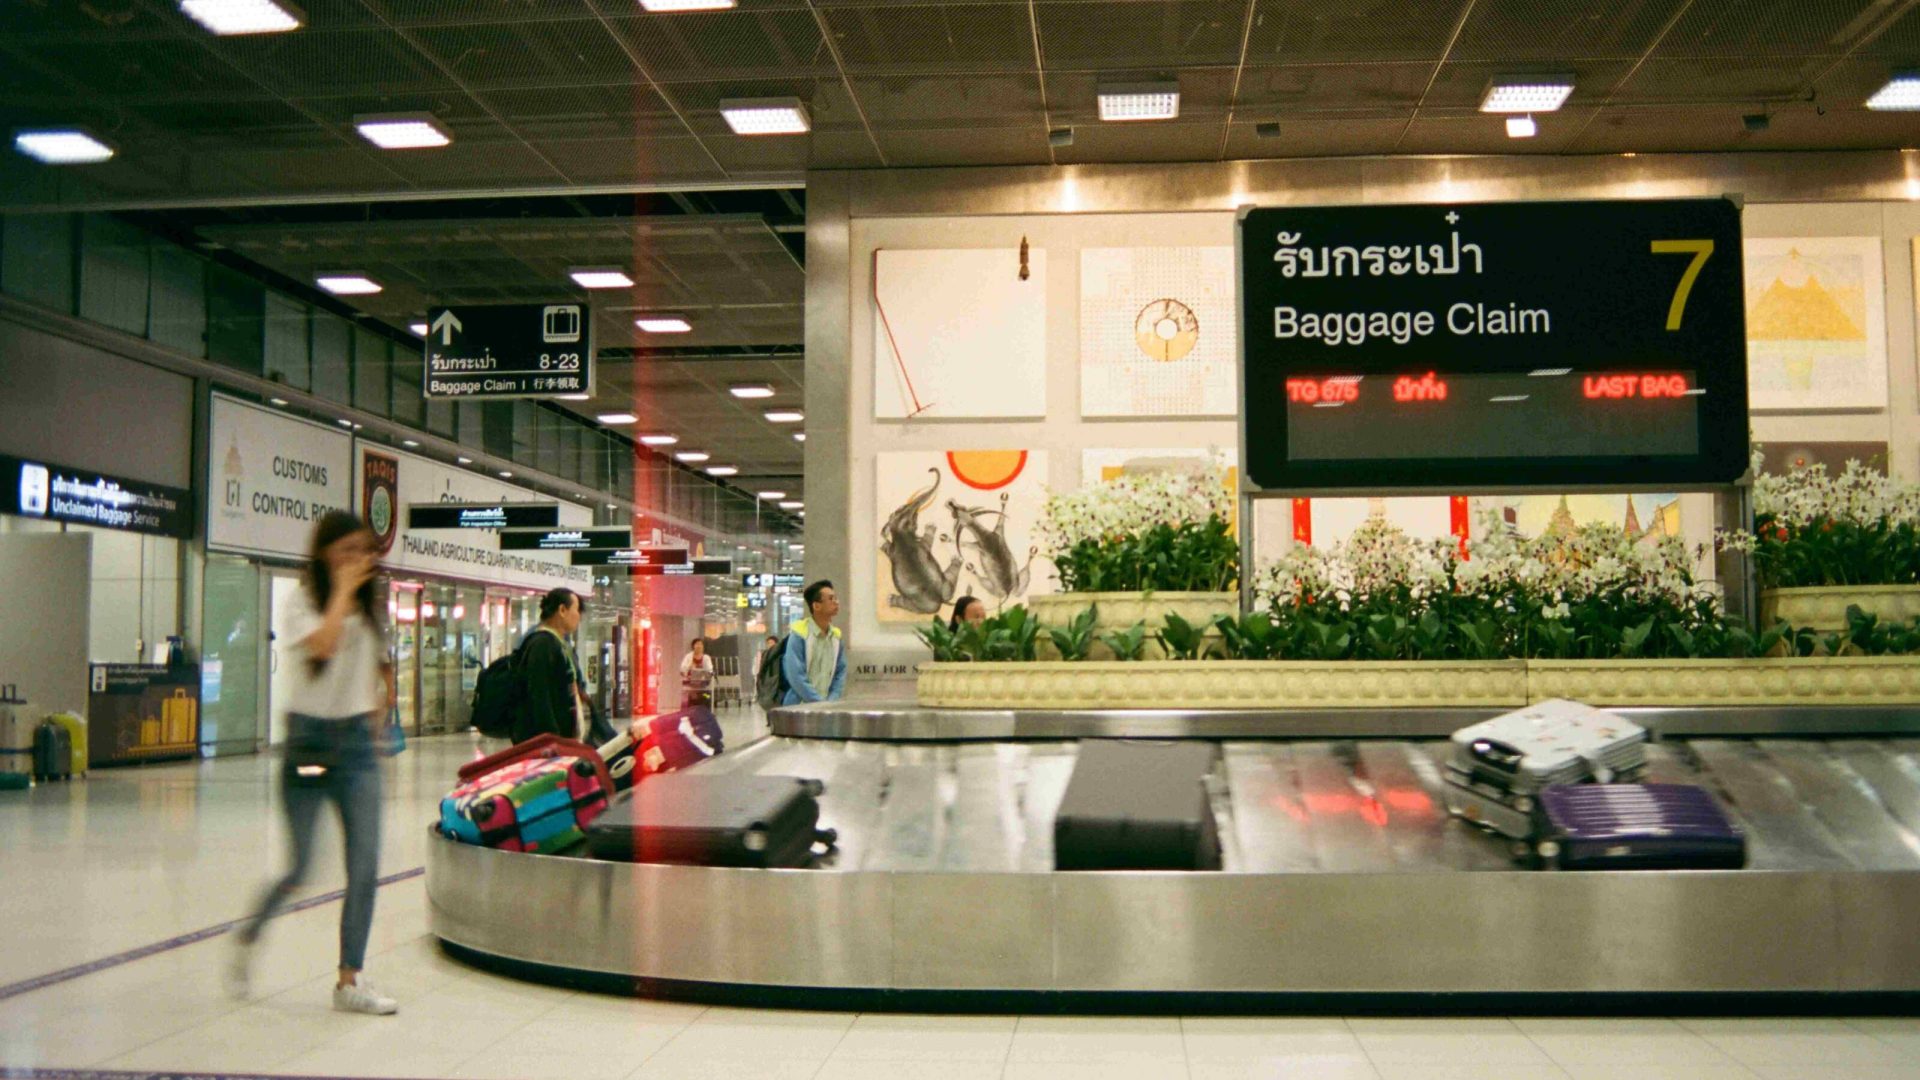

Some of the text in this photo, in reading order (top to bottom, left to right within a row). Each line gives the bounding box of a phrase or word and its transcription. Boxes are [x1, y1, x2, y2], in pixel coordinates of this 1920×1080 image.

[1273, 210, 1483, 278] รับกระเป๋า
[1650, 239, 1715, 331] 7
[1274, 302, 1551, 346] Baggage Claim
[431, 347, 496, 370] รับกระเป๋า
[539, 353, 579, 369] 8-23
[430, 379, 516, 394] Baggage Claim
[1287, 379, 1319, 402] TG
[1583, 373, 1687, 399] LAST BAG
[273, 456, 328, 486] CUSTOMS
[52, 497, 160, 527] Unclaimed Baggage Service
[252, 492, 309, 521] CONTROL
[402, 534, 588, 583] THAILAND AGRICULTURE QUARANTINE AND INSPECTION SERVICE
[856, 664, 876, 674] ART
[884, 664, 907, 674] FOR
